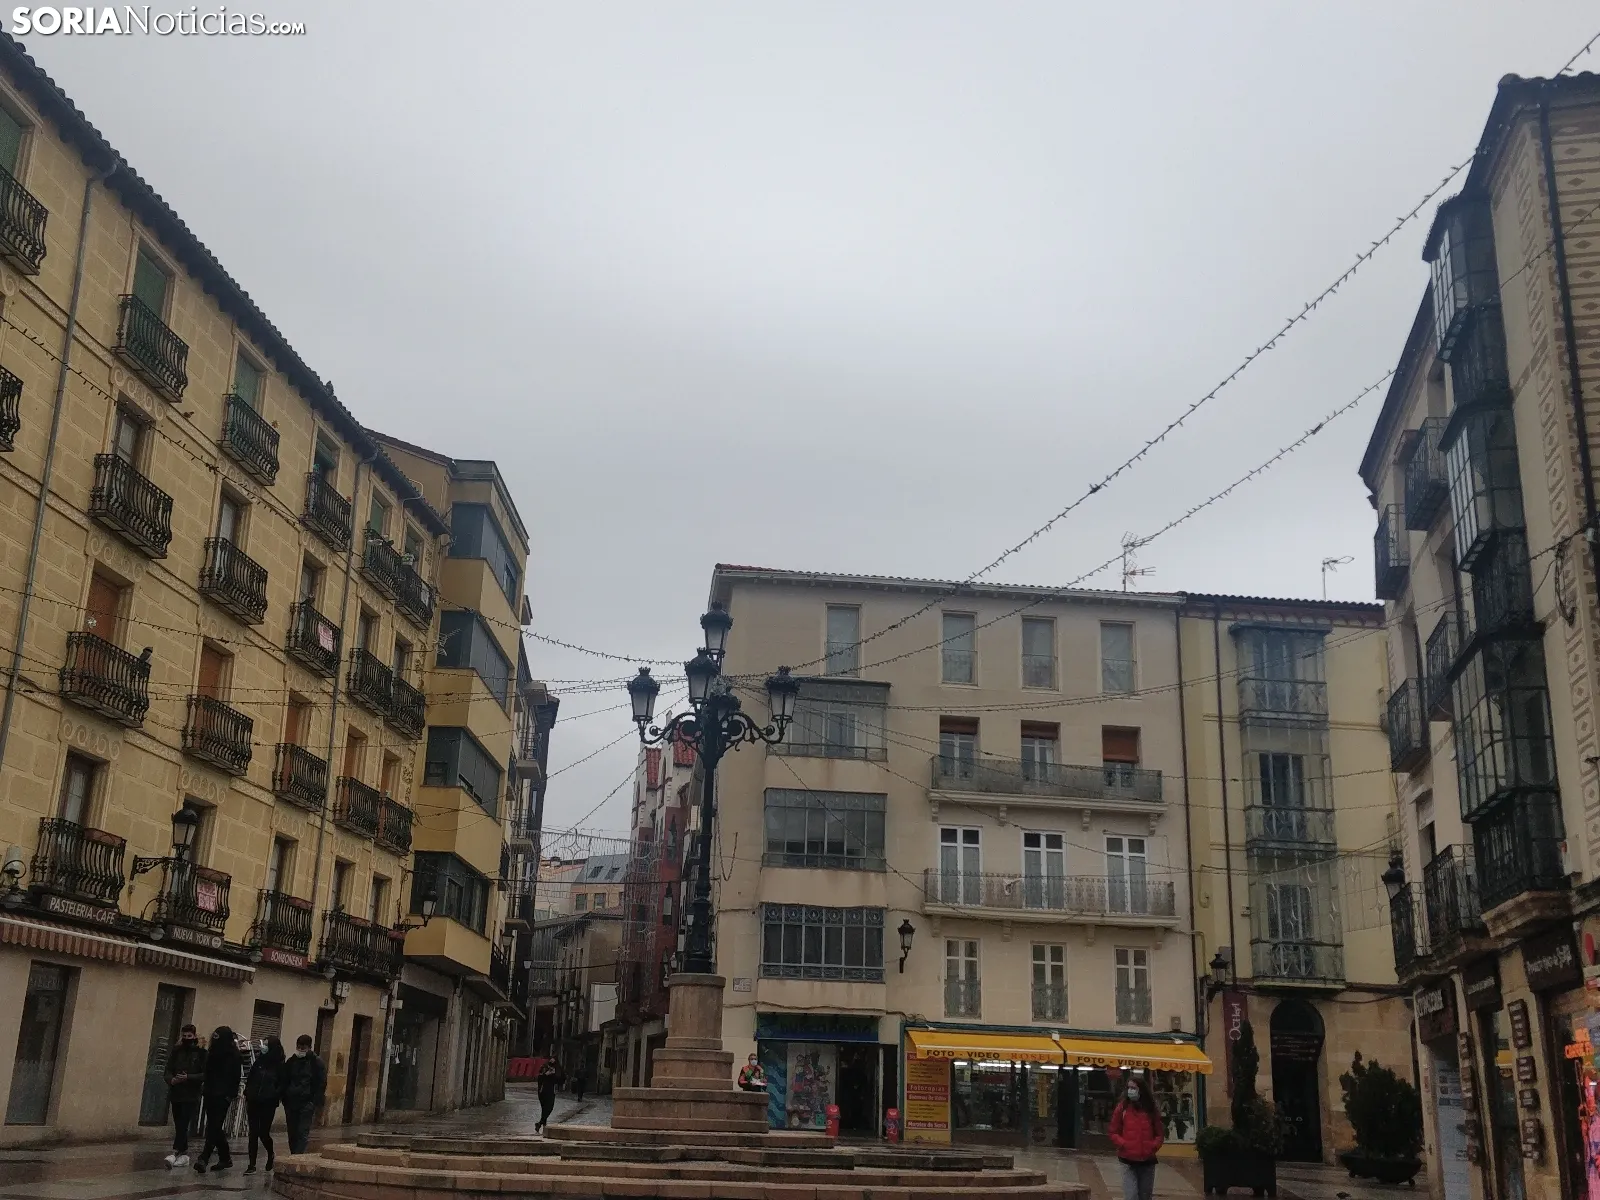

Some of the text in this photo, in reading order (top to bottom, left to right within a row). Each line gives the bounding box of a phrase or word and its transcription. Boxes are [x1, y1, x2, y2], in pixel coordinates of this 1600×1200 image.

[172, 927, 211, 947] NUEVA YORK
[926, 1049, 955, 1057] FOTO
[967, 1051, 1000, 1059] VIDEO
[1077, 1056, 1105, 1064] FOTO
[1117, 1058, 1150, 1067] VIDEO
[1160, 1061, 1202, 1071] ROSEL
